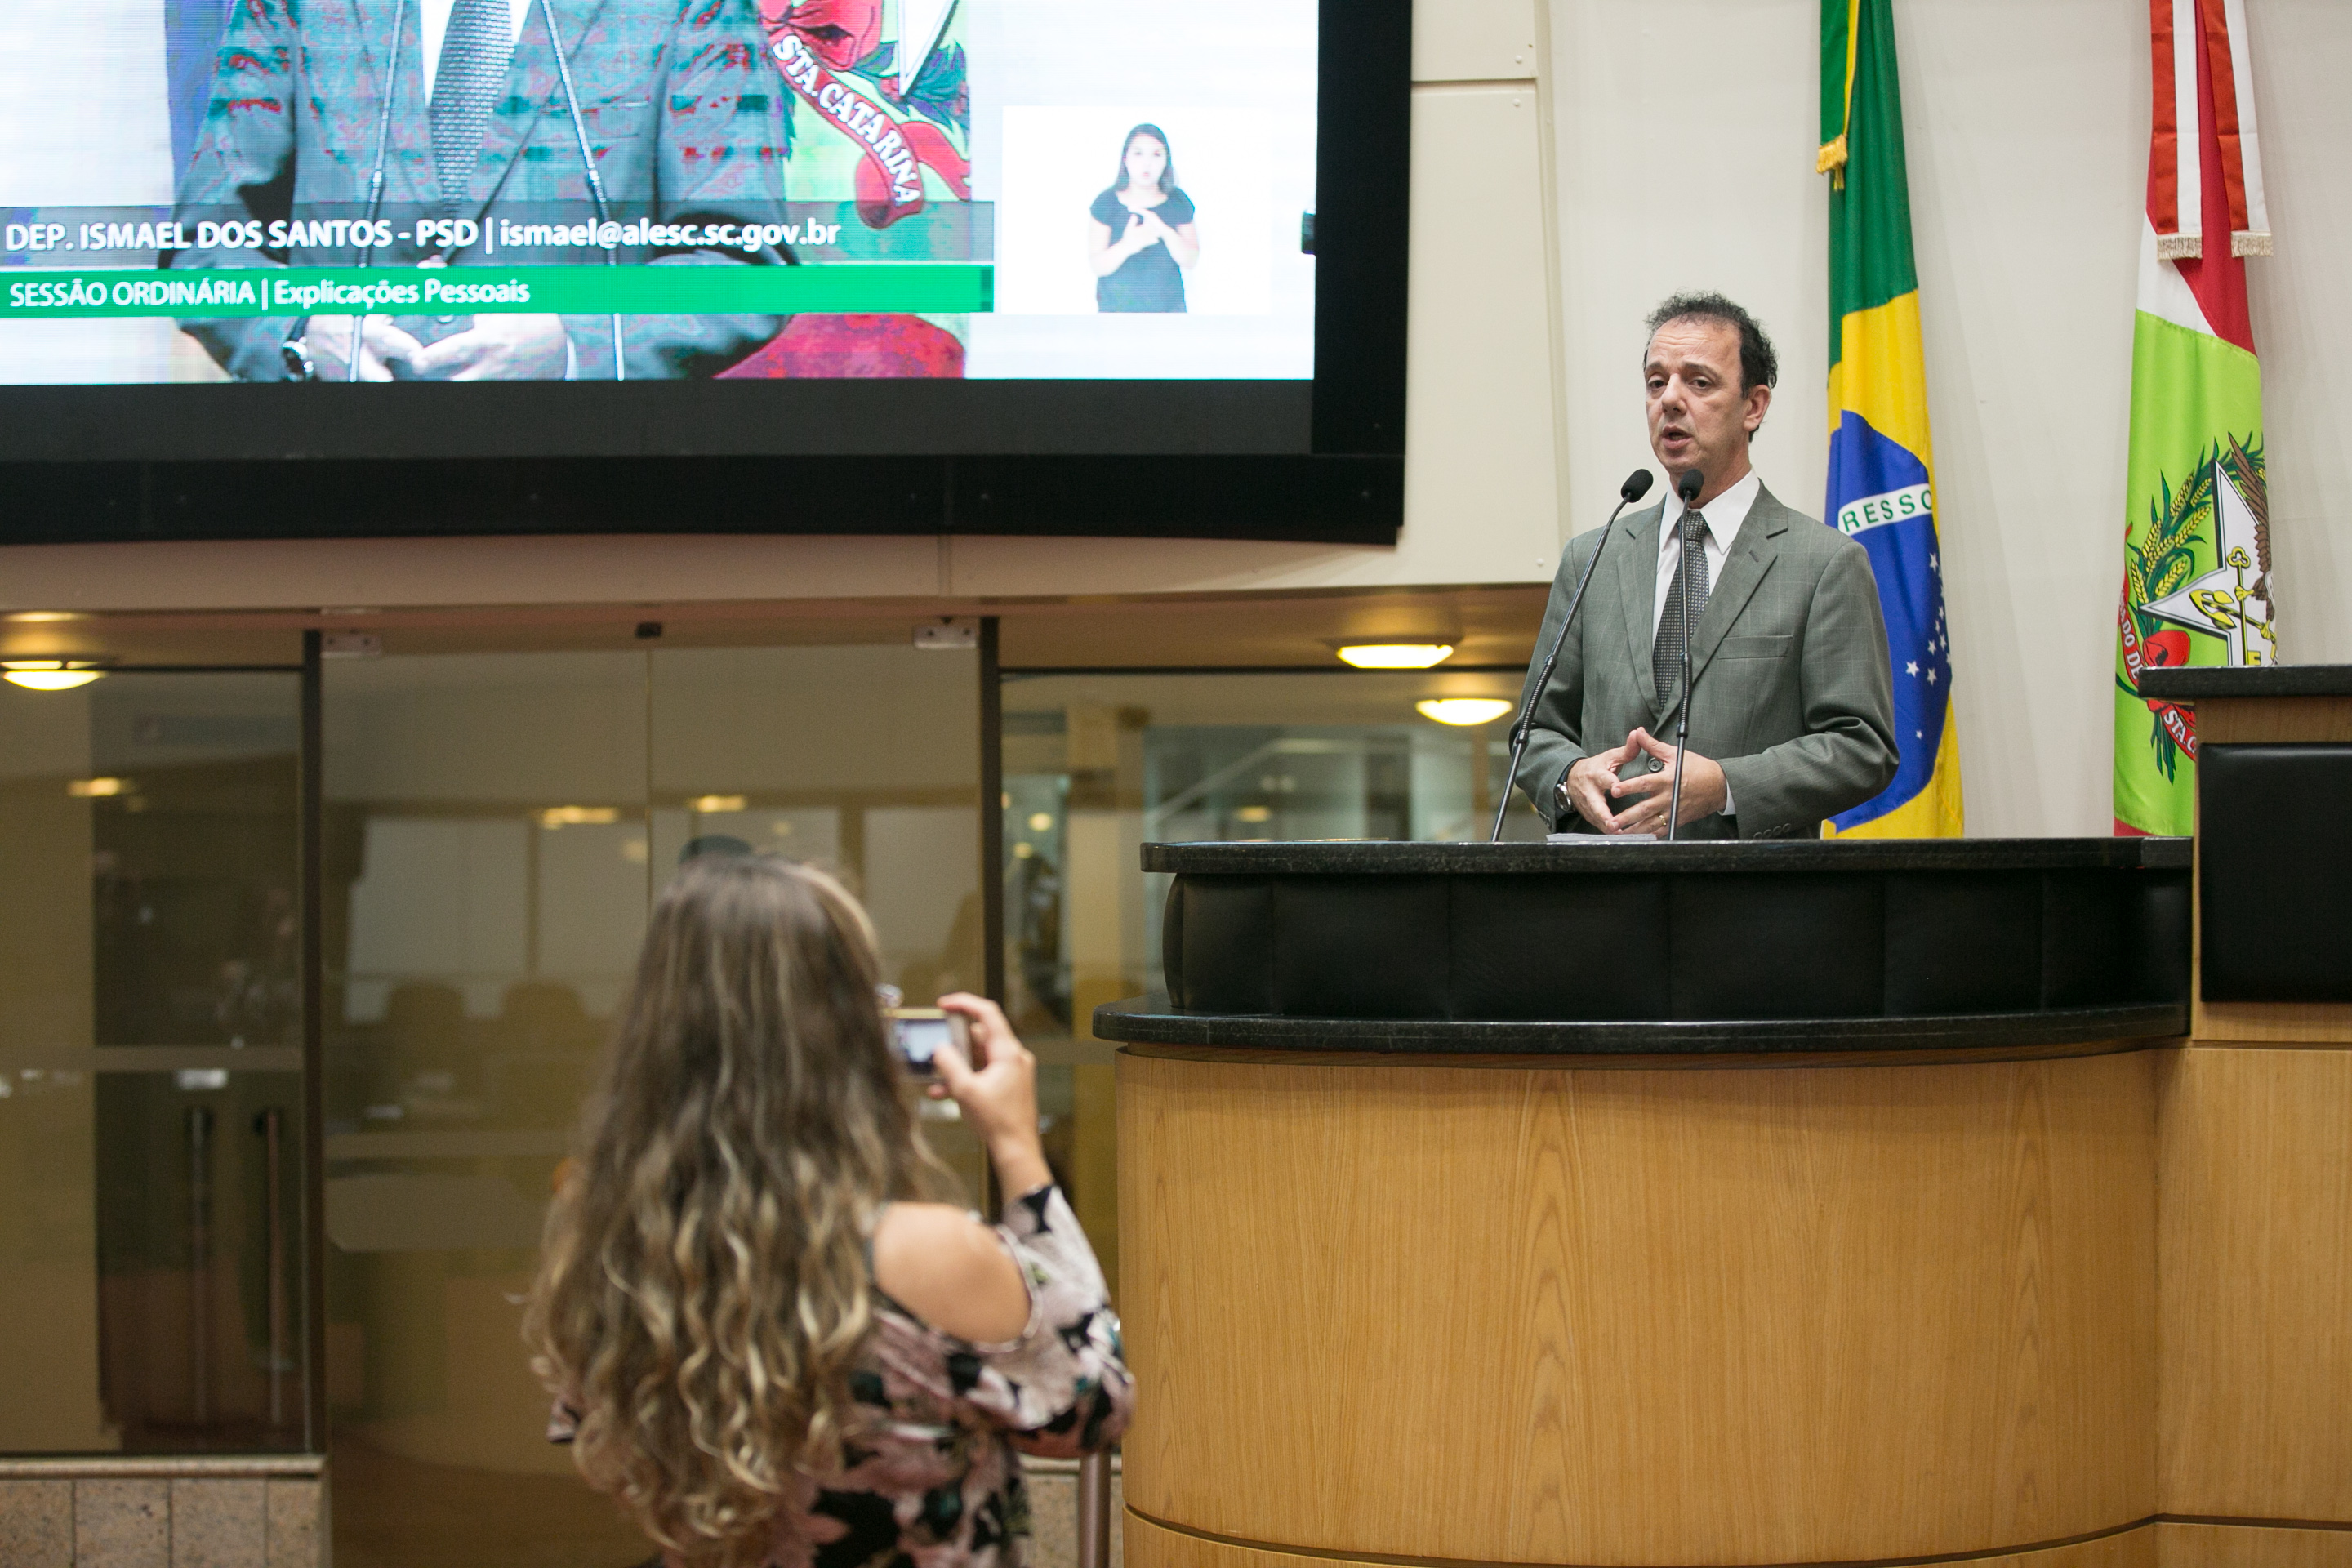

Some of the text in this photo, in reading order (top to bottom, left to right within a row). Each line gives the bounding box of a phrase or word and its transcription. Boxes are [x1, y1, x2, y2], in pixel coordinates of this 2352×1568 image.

[819, 82, 921, 207] CATARINA
[6, 223, 74, 251] DEP.
[80, 221, 193, 251] ISMAEL
[197, 220, 263, 249] DOS
[269, 219, 394, 249] SANTOS
[416, 218, 479, 247] PSD
[500, 216, 842, 252] ismael@alesc.sc.gov.br
[10, 278, 108, 307] SESSÃO
[112, 277, 256, 307] ORDINÁRIA
[274, 278, 420, 310] Explicações
[424, 278, 531, 303] Pessoais
